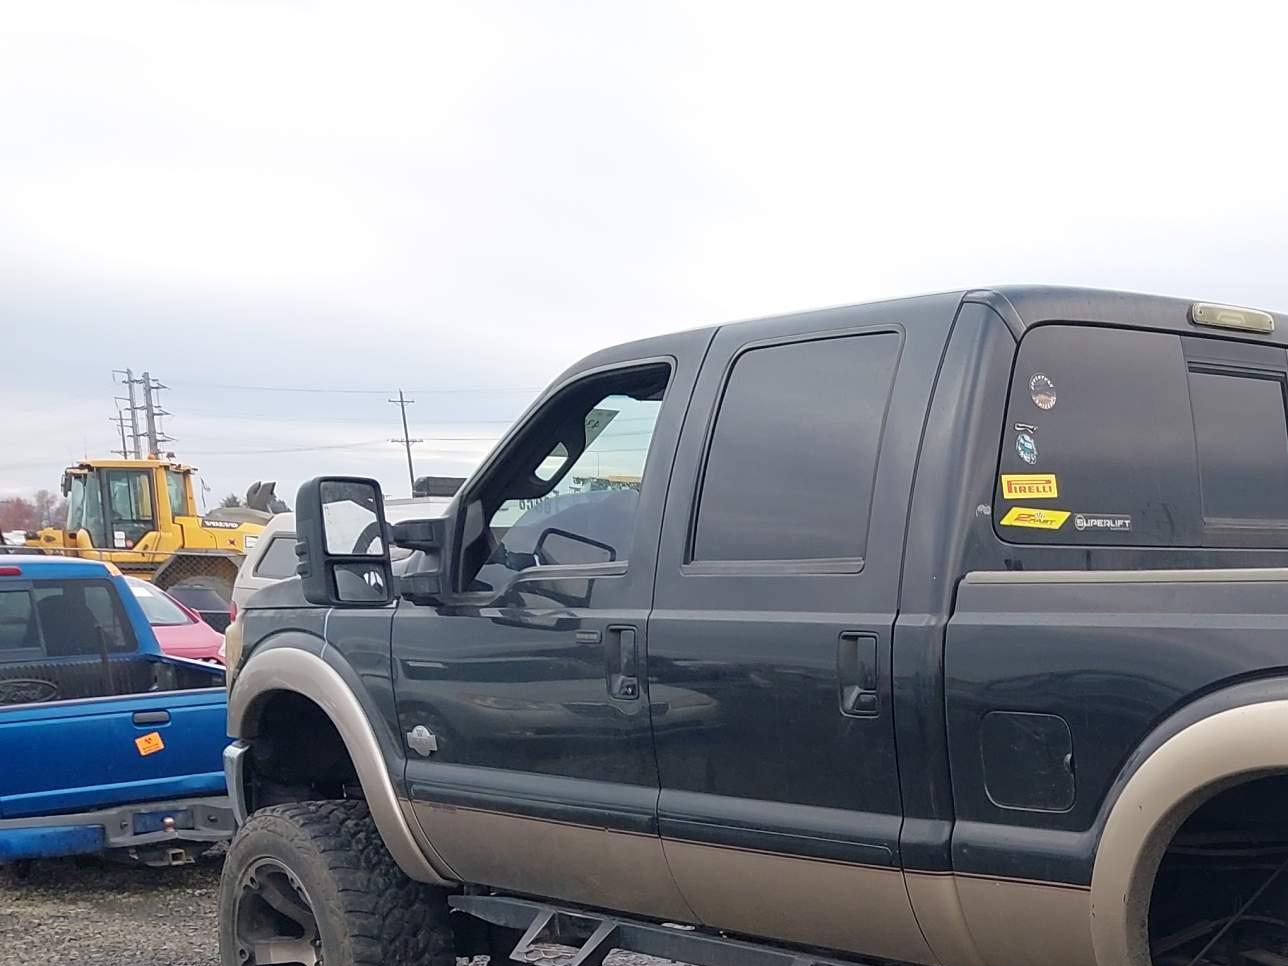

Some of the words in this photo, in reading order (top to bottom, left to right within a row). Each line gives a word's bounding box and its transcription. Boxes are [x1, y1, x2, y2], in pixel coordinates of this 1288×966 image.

[1006, 479, 1053, 494] PIRELLI
[204, 520, 239, 529] VOLVO
[1074, 514, 1131, 531] SUPERLIFT
